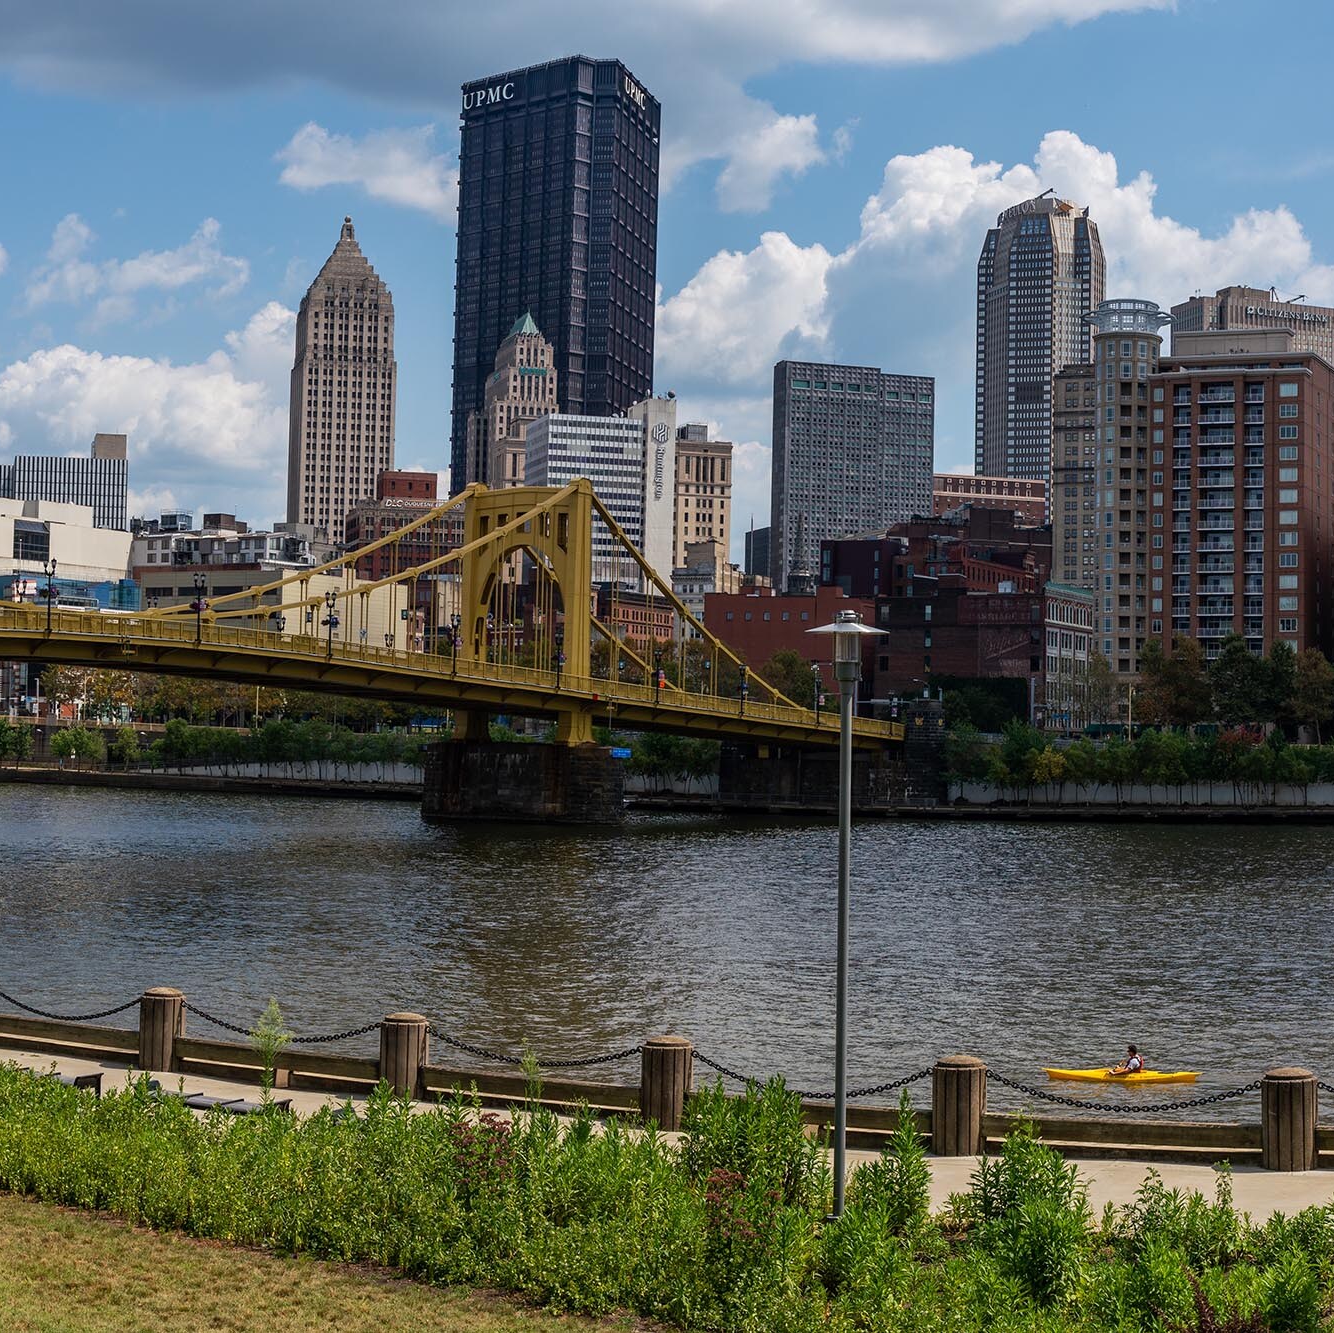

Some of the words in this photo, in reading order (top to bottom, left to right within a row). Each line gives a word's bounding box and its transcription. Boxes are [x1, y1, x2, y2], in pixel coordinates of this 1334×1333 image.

[463, 83, 515, 110] UPMC
[625, 76, 646, 111] UPMC
[1257, 304, 1301, 320] CITIZENS
[1303, 311, 1328, 322] BANK
